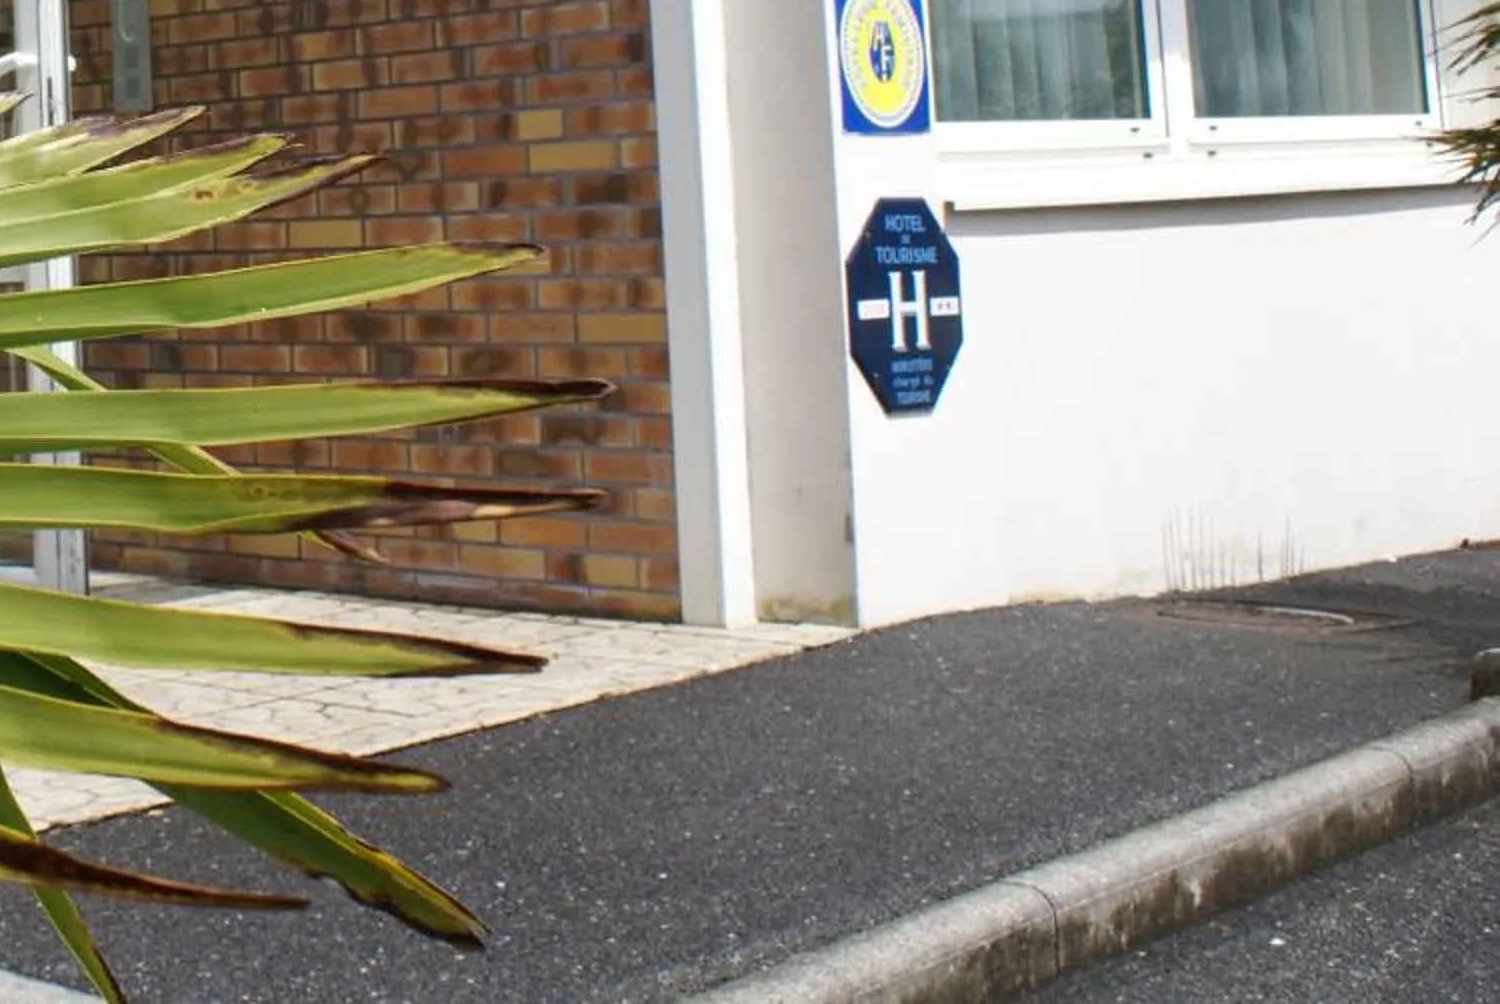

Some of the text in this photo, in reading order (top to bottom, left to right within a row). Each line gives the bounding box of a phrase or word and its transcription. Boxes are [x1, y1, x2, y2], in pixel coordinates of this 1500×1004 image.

[884, 214, 927, 232] HOTEL
[874, 246, 938, 264] TOURISME
[888, 270, 932, 353] H
